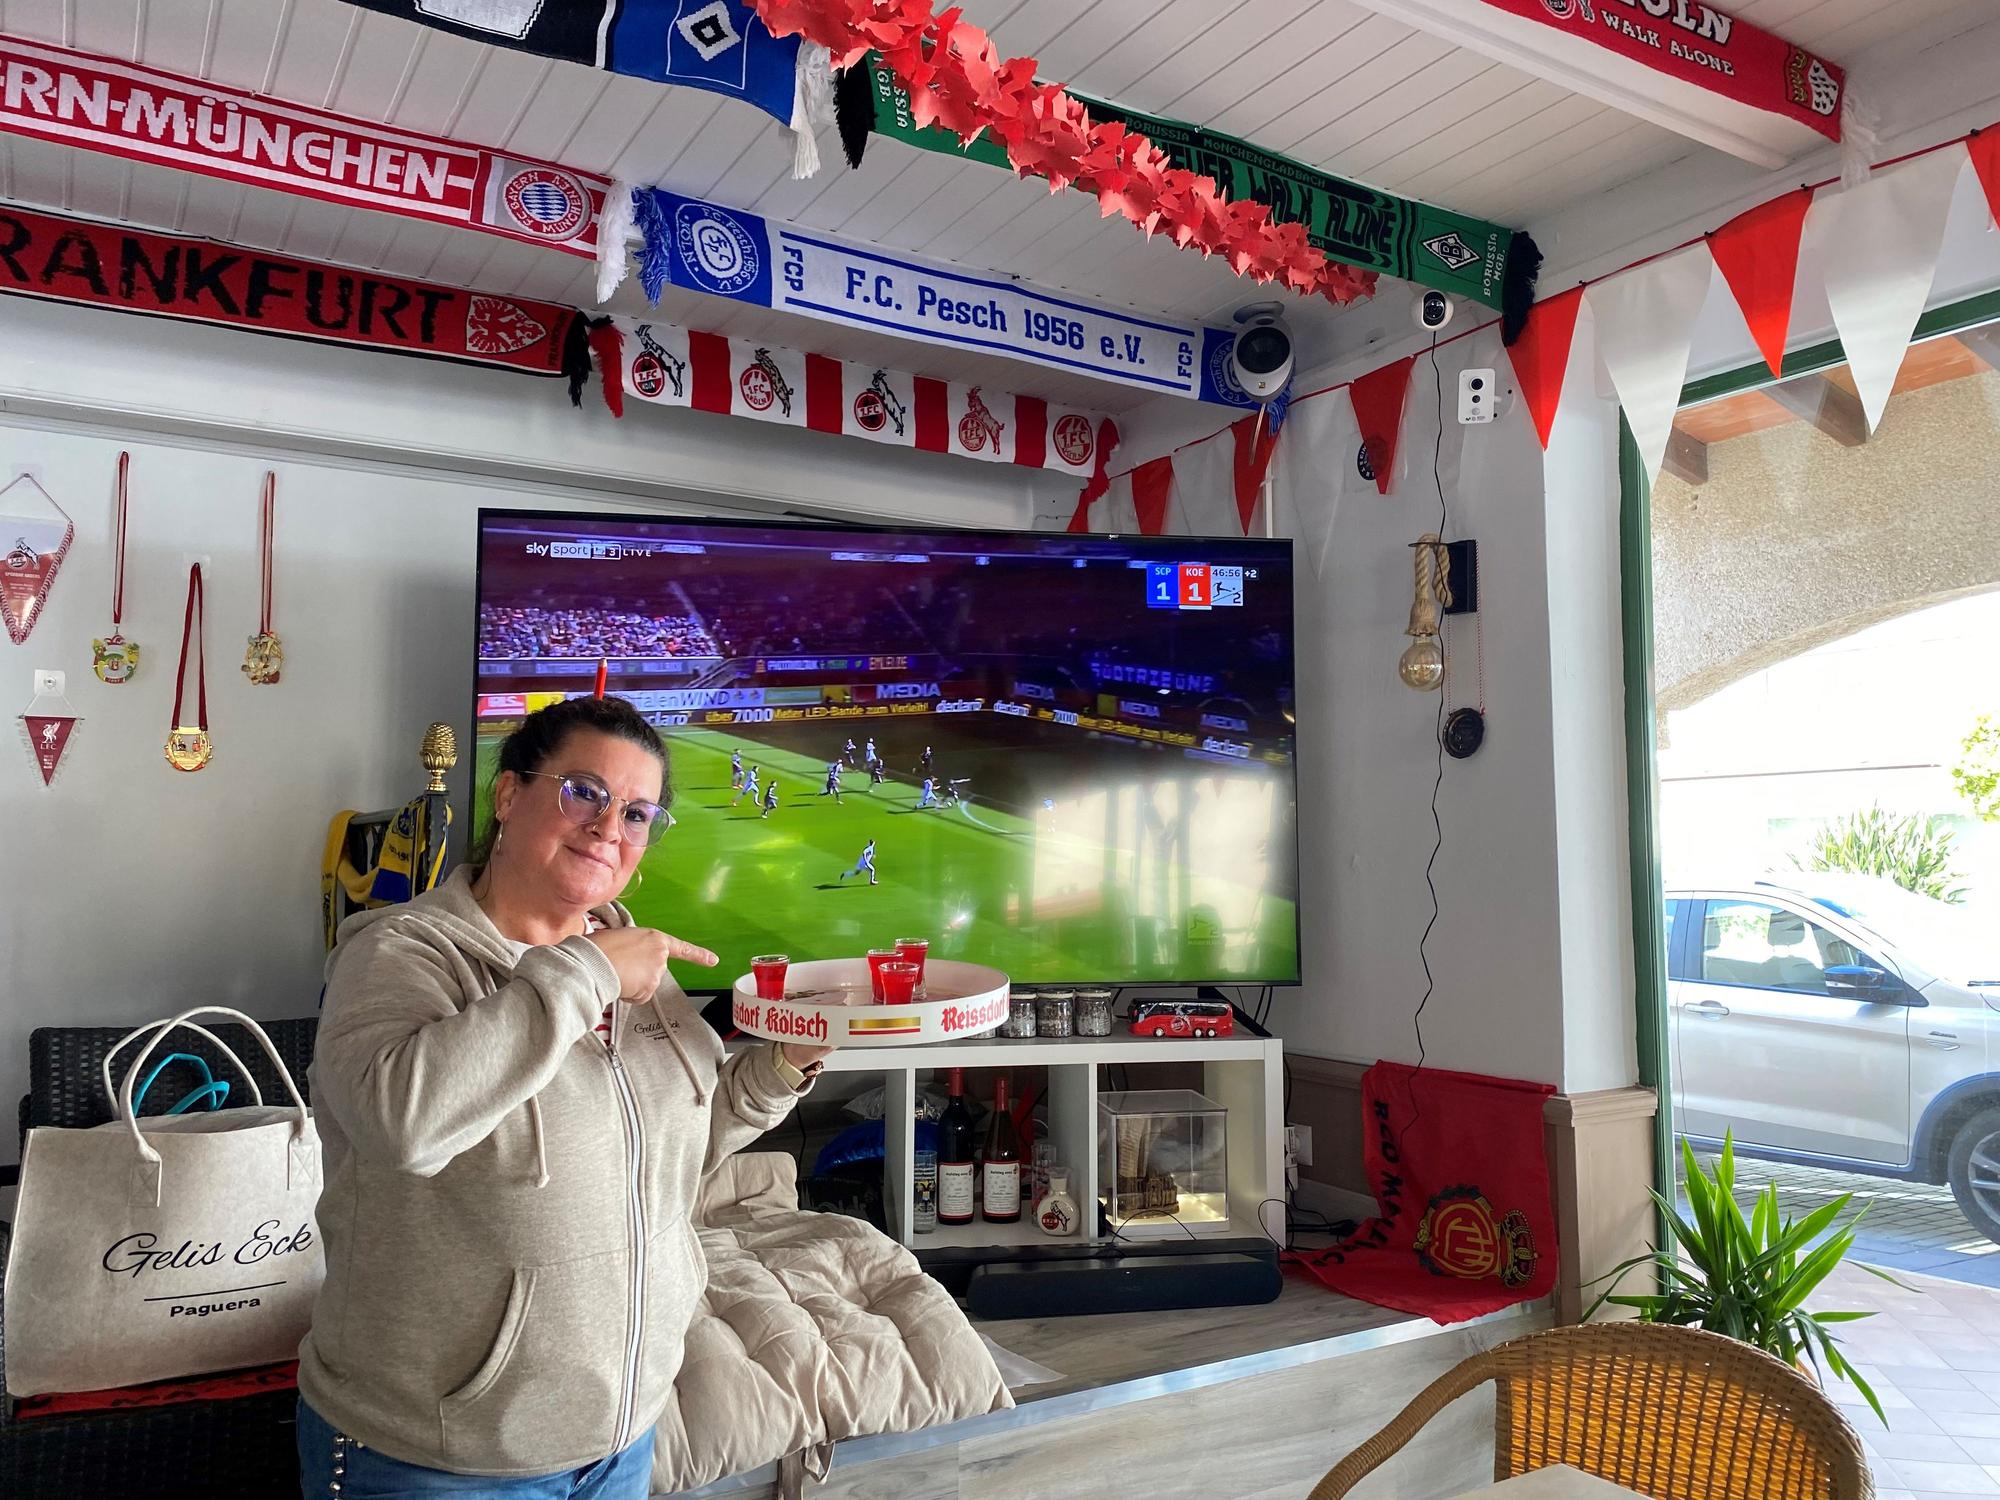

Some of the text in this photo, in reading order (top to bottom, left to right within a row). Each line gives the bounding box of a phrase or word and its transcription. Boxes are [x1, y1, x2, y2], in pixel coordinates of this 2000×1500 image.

[1601, 10, 1735, 76] WALK ALONE
[0, 59, 469, 199] RN-MÜNCHEN-
[1124, 116, 1190, 142] BORUSSIA
[509, 172, 539, 209] BAYERN
[542, 190, 582, 233] MÜNCHEN
[680, 220, 697, 263] KÖLN
[1325, 196, 1397, 254] ALONE
[726, 221, 753, 254] Pesch
[742, 254, 757, 280] 1956
[783, 245, 803, 291] FCP
[1483, 233, 1498, 297] BORUSSIA
[846, 267, 1146, 365] F.C. Pesch 1956 e.V.
[638, 369, 657, 381] 1.FC
[1178, 342, 1192, 378] FCP
[860, 405, 880, 417] 1.FC
[526, 542, 652, 557] sky sport 3 LIVE
[1155, 567, 1257, 578] SCP KOE 46:56 +2
[1156, 582, 1241, 604] 1 1 2
[876, 683, 941, 699] MEDIA
[733, 708, 774, 723] 7000
[734, 1002, 828, 1043] sdorf Kölsch
[941, 993, 1008, 1033] Reissdorf
[1374, 1100, 1400, 1164] RCD
[102, 1219, 314, 1278] Gelis Eck
[170, 1297, 261, 1317] Paguera
